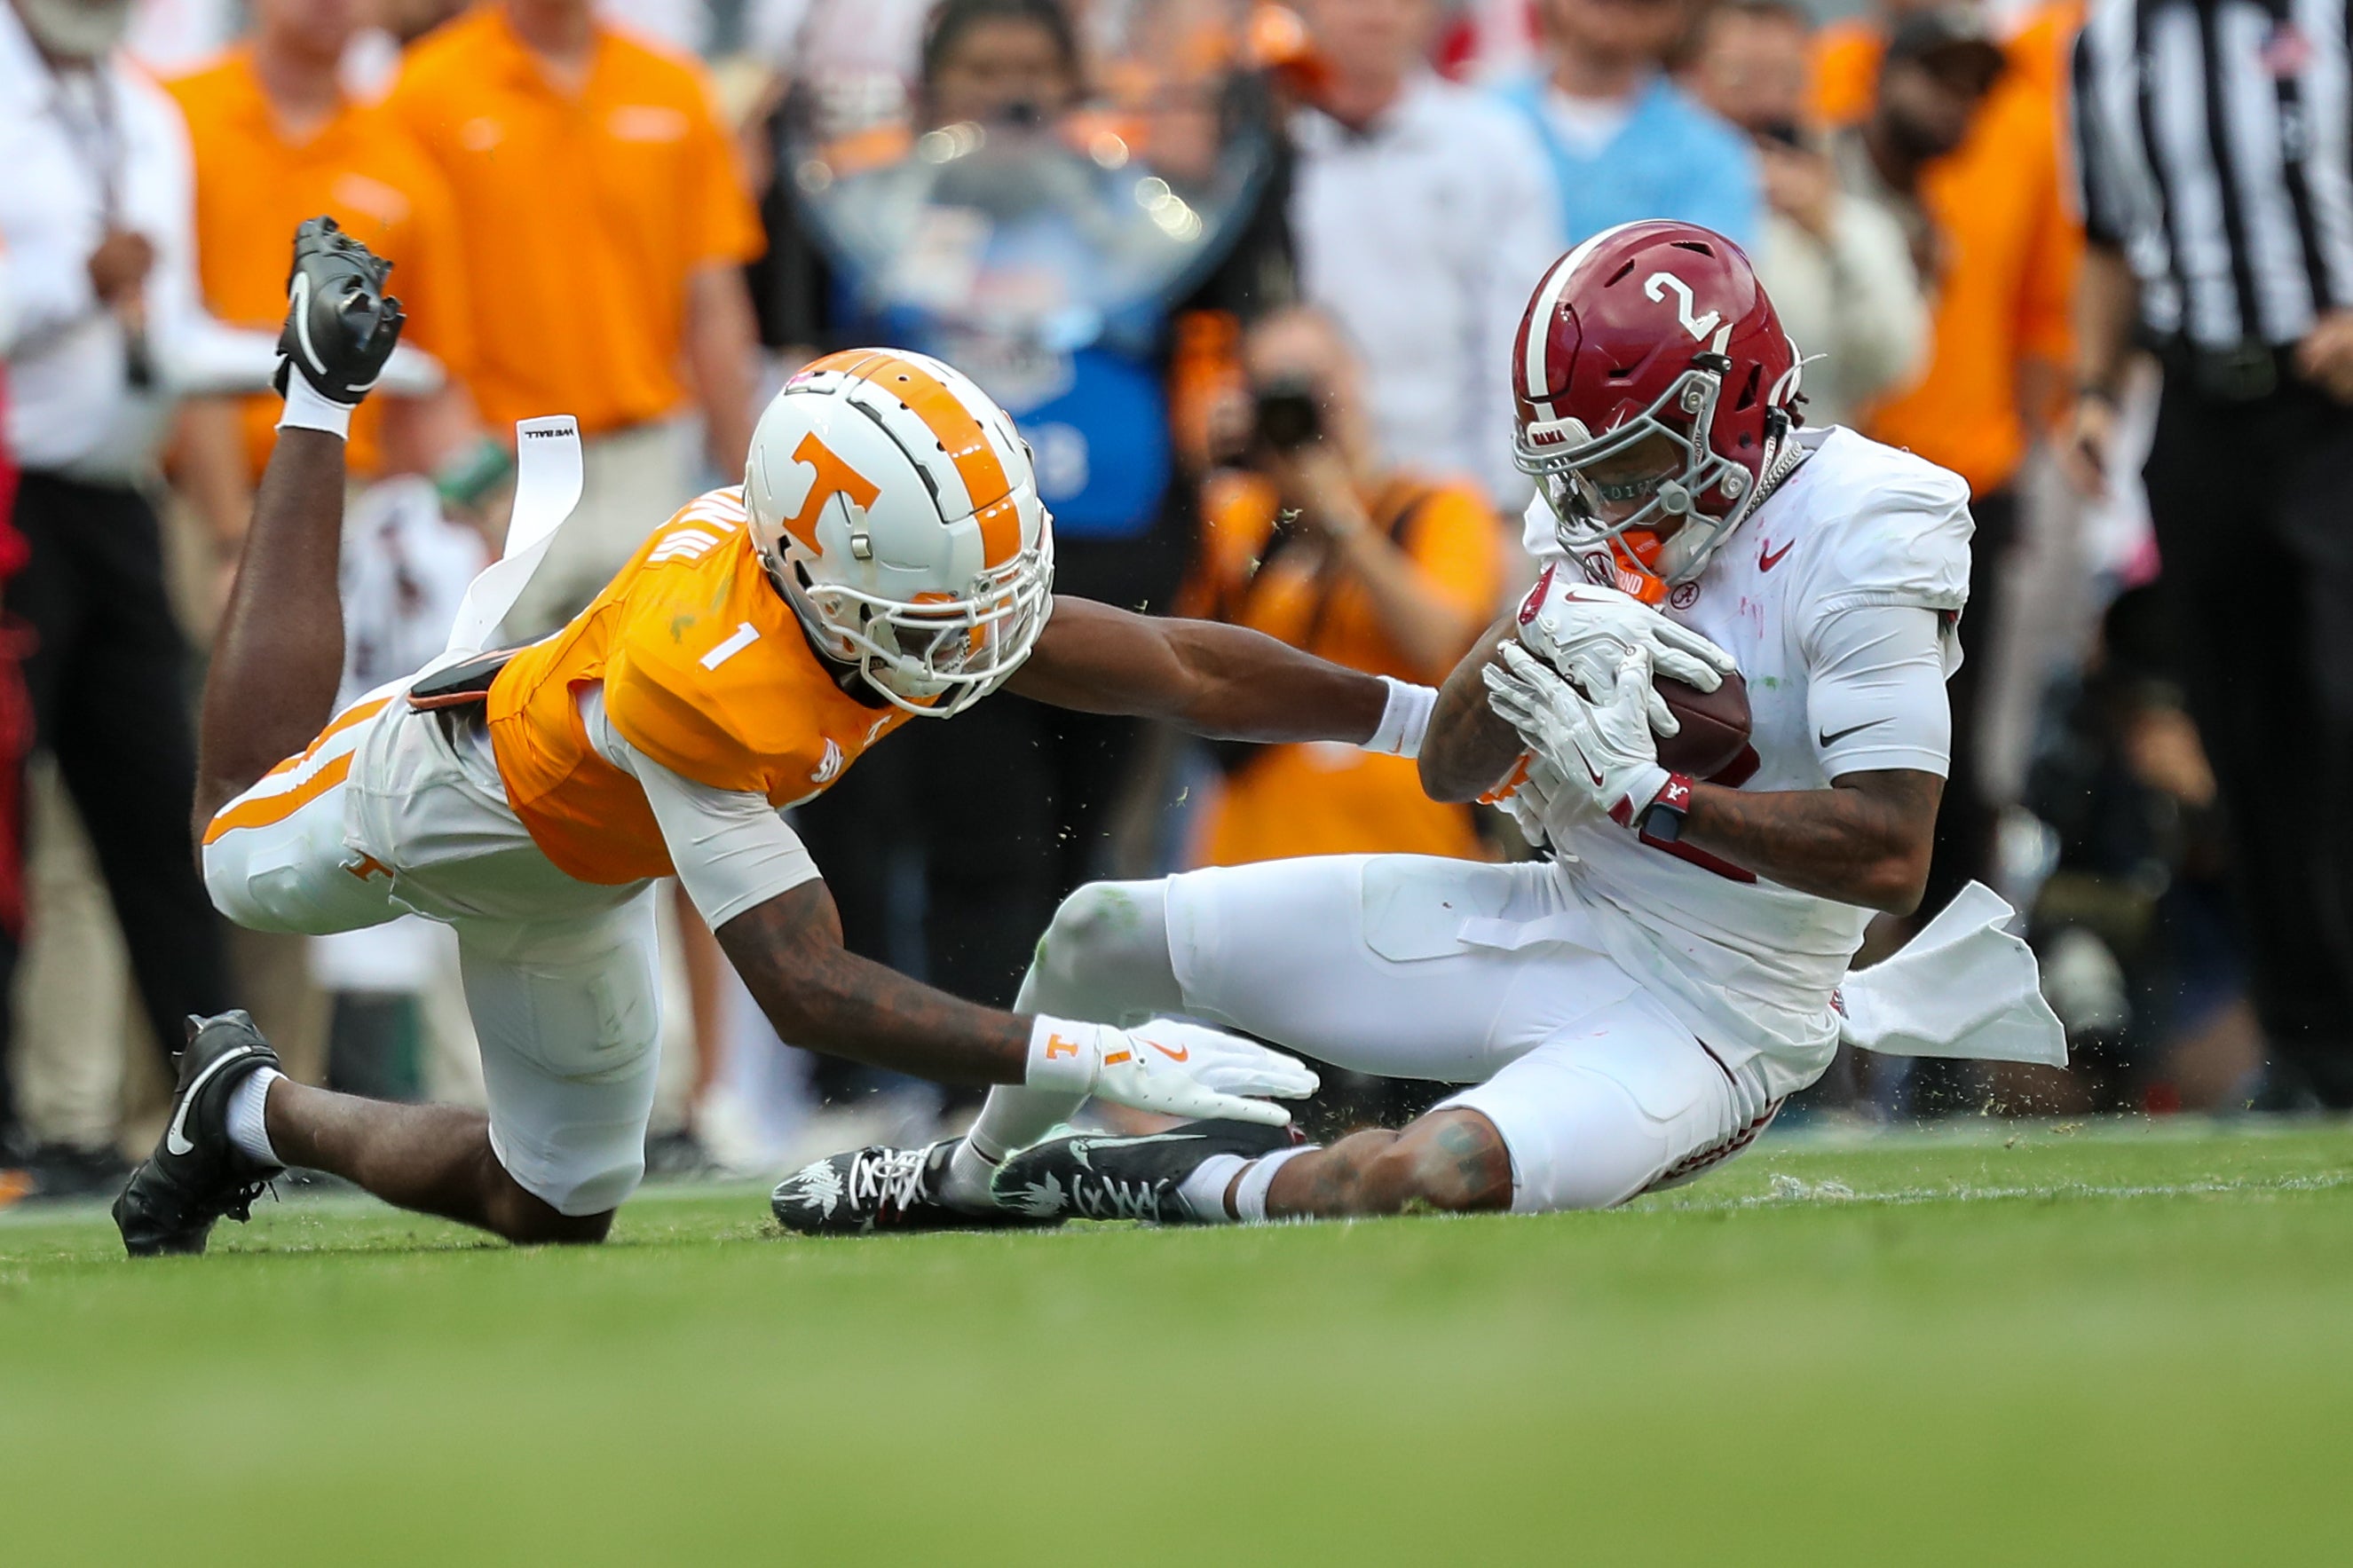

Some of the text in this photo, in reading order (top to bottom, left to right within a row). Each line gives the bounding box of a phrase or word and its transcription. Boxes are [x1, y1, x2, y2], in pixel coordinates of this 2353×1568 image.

[1644, 272, 1721, 343] 2
[525, 428, 574, 439] WE BALL
[782, 430, 881, 557] T
[699, 621, 761, 671] 1
[1046, 1033, 1079, 1060] T
